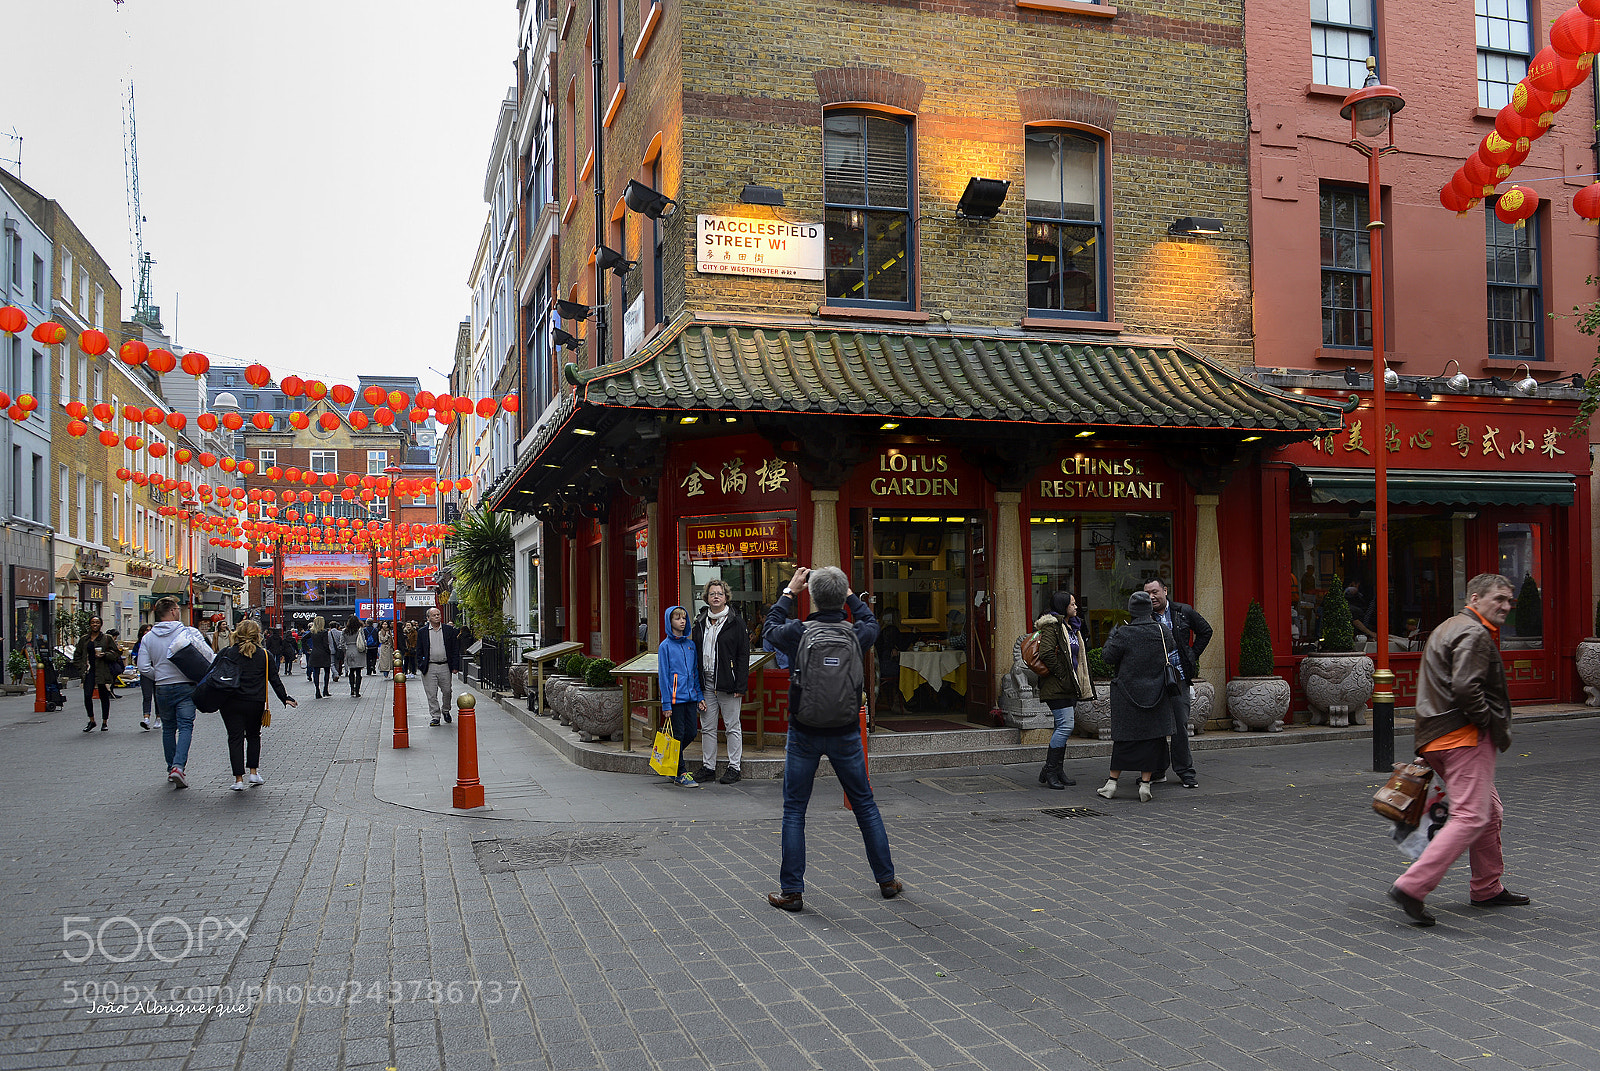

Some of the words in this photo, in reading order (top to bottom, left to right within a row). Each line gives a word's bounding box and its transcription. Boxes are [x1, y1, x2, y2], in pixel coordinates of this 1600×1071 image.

[704, 219, 818, 239] MACCLESFIELD
[704, 234, 762, 249] STREET
[768, 238, 787, 251] W1
[702, 263, 717, 271] CITY
[719, 264, 729, 272] OF
[730, 265, 779, 275] WESTMINSTER
[880, 454, 948, 473] LOTUS
[1060, 457, 1145, 476] CHINESE
[870, 477, 958, 496] GARDEN
[1040, 480, 1165, 499] RESTAURANT
[697, 529, 716, 540] DIM
[718, 528, 742, 539] SUM
[744, 526, 776, 538] DAILY
